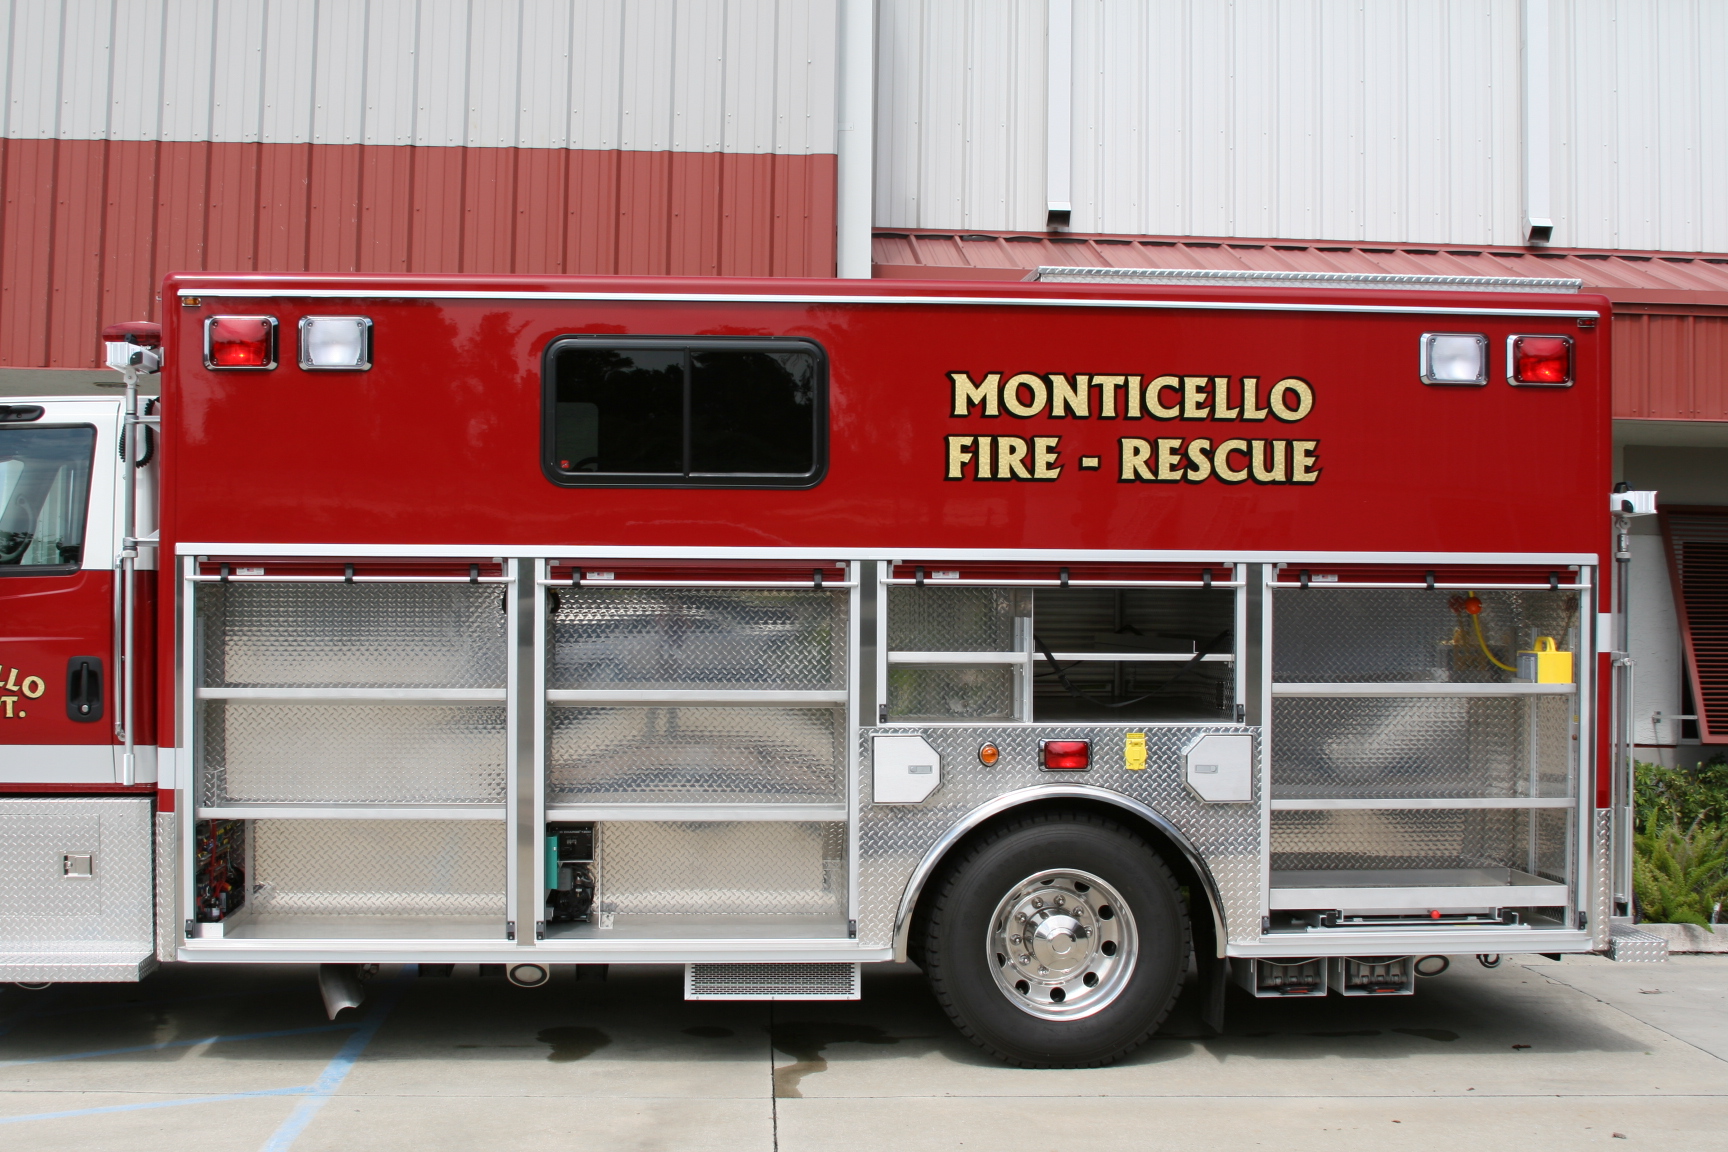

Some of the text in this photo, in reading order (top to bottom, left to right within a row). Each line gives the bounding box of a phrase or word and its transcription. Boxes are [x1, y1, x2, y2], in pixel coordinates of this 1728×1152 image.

[946, 372, 1315, 422] MONTICELLO
[946, 435, 1063, 482] FIRE
[1118, 437, 1322, 484] RESCUE
[0, 695, 26, 718] T.
